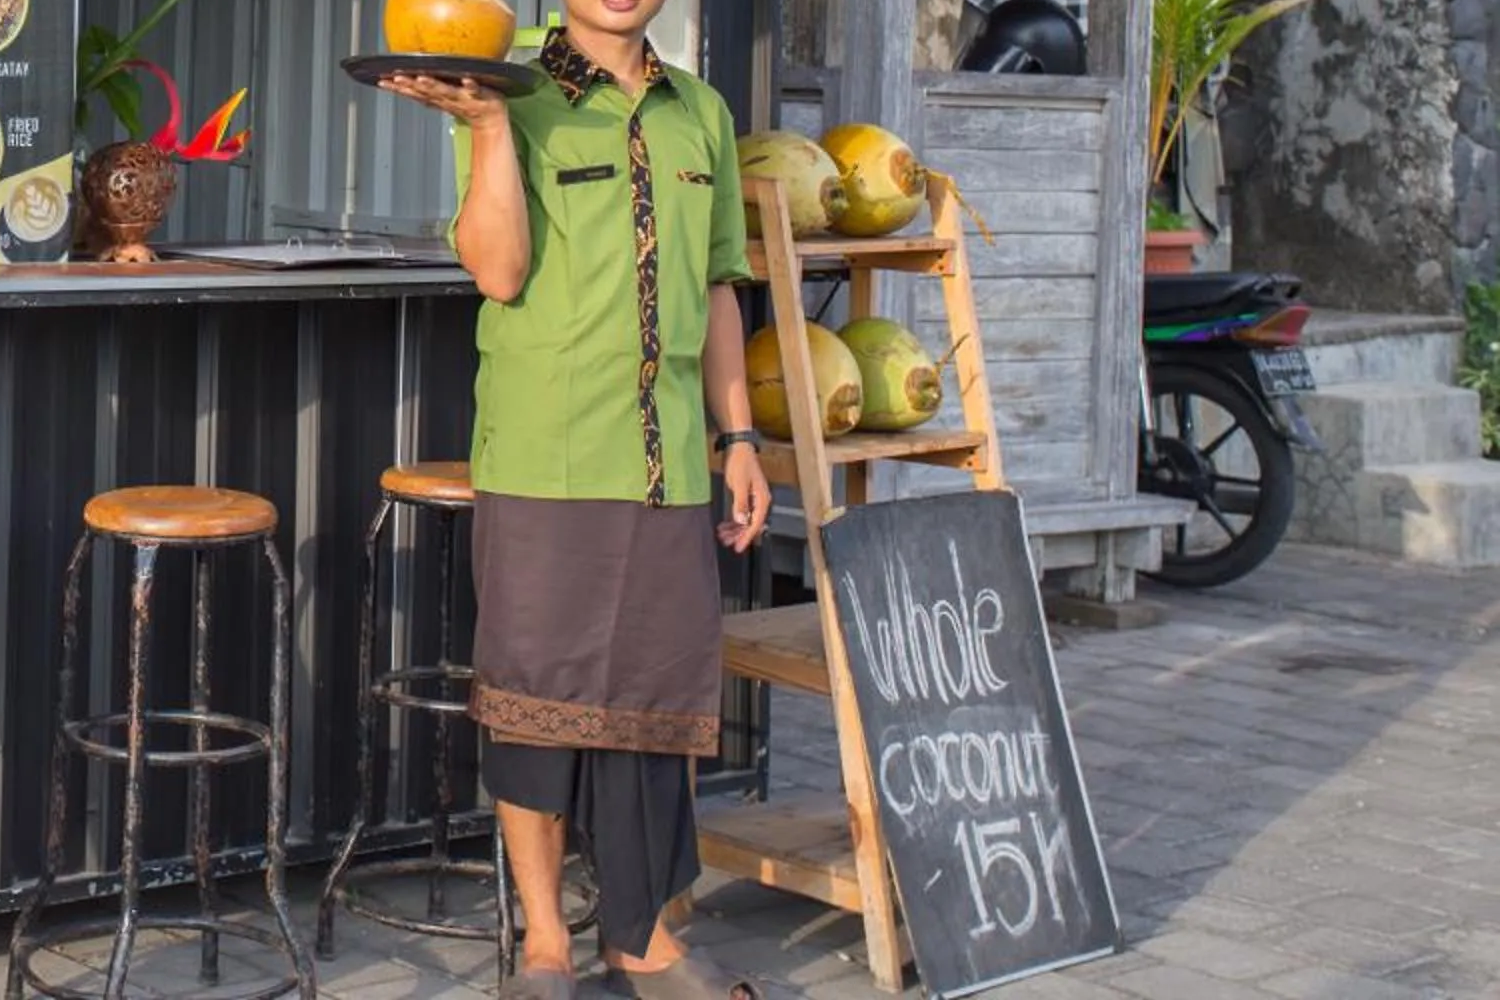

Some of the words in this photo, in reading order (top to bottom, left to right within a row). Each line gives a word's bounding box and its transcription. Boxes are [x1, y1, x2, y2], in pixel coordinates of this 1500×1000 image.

[7, 116, 40, 134] FRIED
[7, 133, 34, 148] RICE
[841, 539, 1011, 706] Whole
